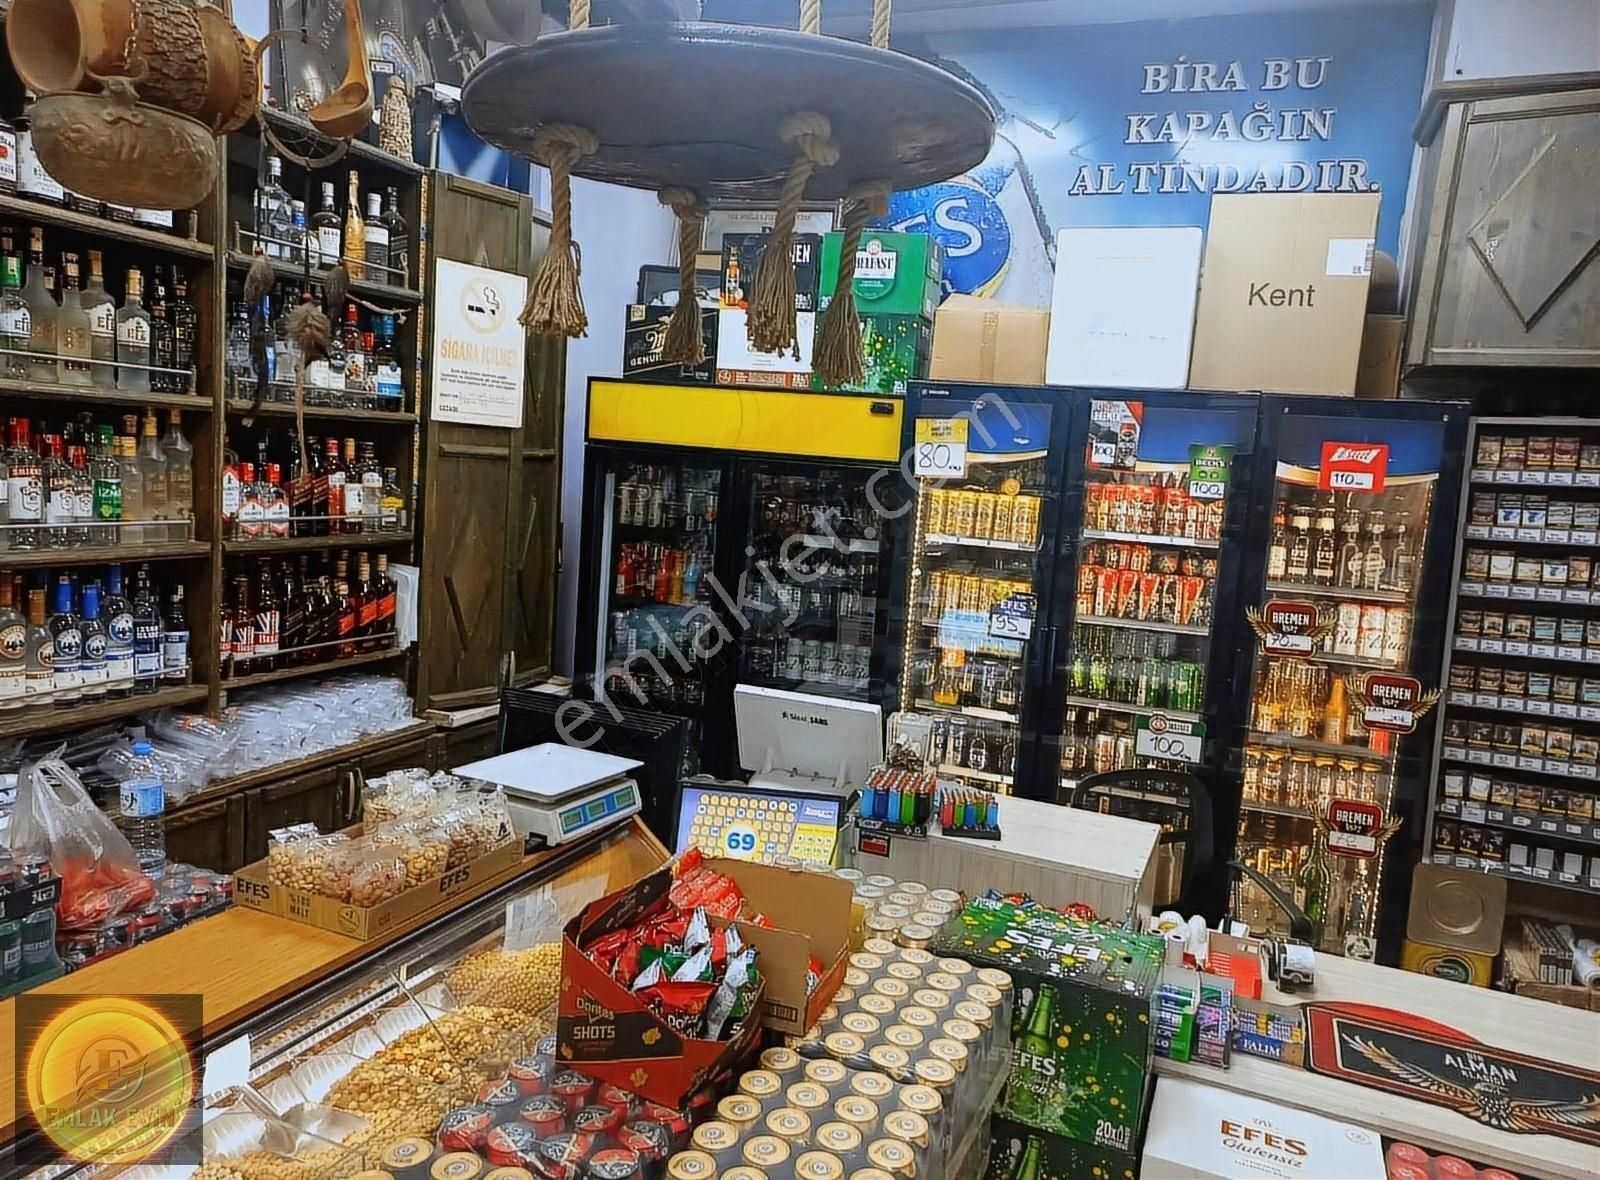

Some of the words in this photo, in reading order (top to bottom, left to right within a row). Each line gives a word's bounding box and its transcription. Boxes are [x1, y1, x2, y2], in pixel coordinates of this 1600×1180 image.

[1141, 55, 1248, 94] BİRA
[1260, 55, 1333, 91] BU
[1124, 101, 1336, 145] KAPAĞIN
[1068, 158, 1380, 196] ALTINDADIR.
[1247, 281, 1316, 308] Kent
[919, 442, 951, 468] 80
[1191, 482, 1220, 494] 100
[996, 614, 1018, 632] 95
[1272, 611, 1310, 625] BREMEN
[1372, 684, 1412, 700] BREMEN
[1150, 736, 1185, 757] 100
[1336, 809, 1375, 826] BREMEN
[727, 832, 756, 851] 69
[236, 877, 270, 900] EFES
[438, 865, 471, 892] EFES
[1004, 928, 1102, 961] EFES
[573, 1024, 616, 1040] SHOTS
[1242, 1038, 1281, 1057] FALIM
[1444, 1053, 1518, 1082] ALMAN
[1221, 1119, 1307, 1156] EFES
[1223, 1138, 1304, 1168] Glutensiz
